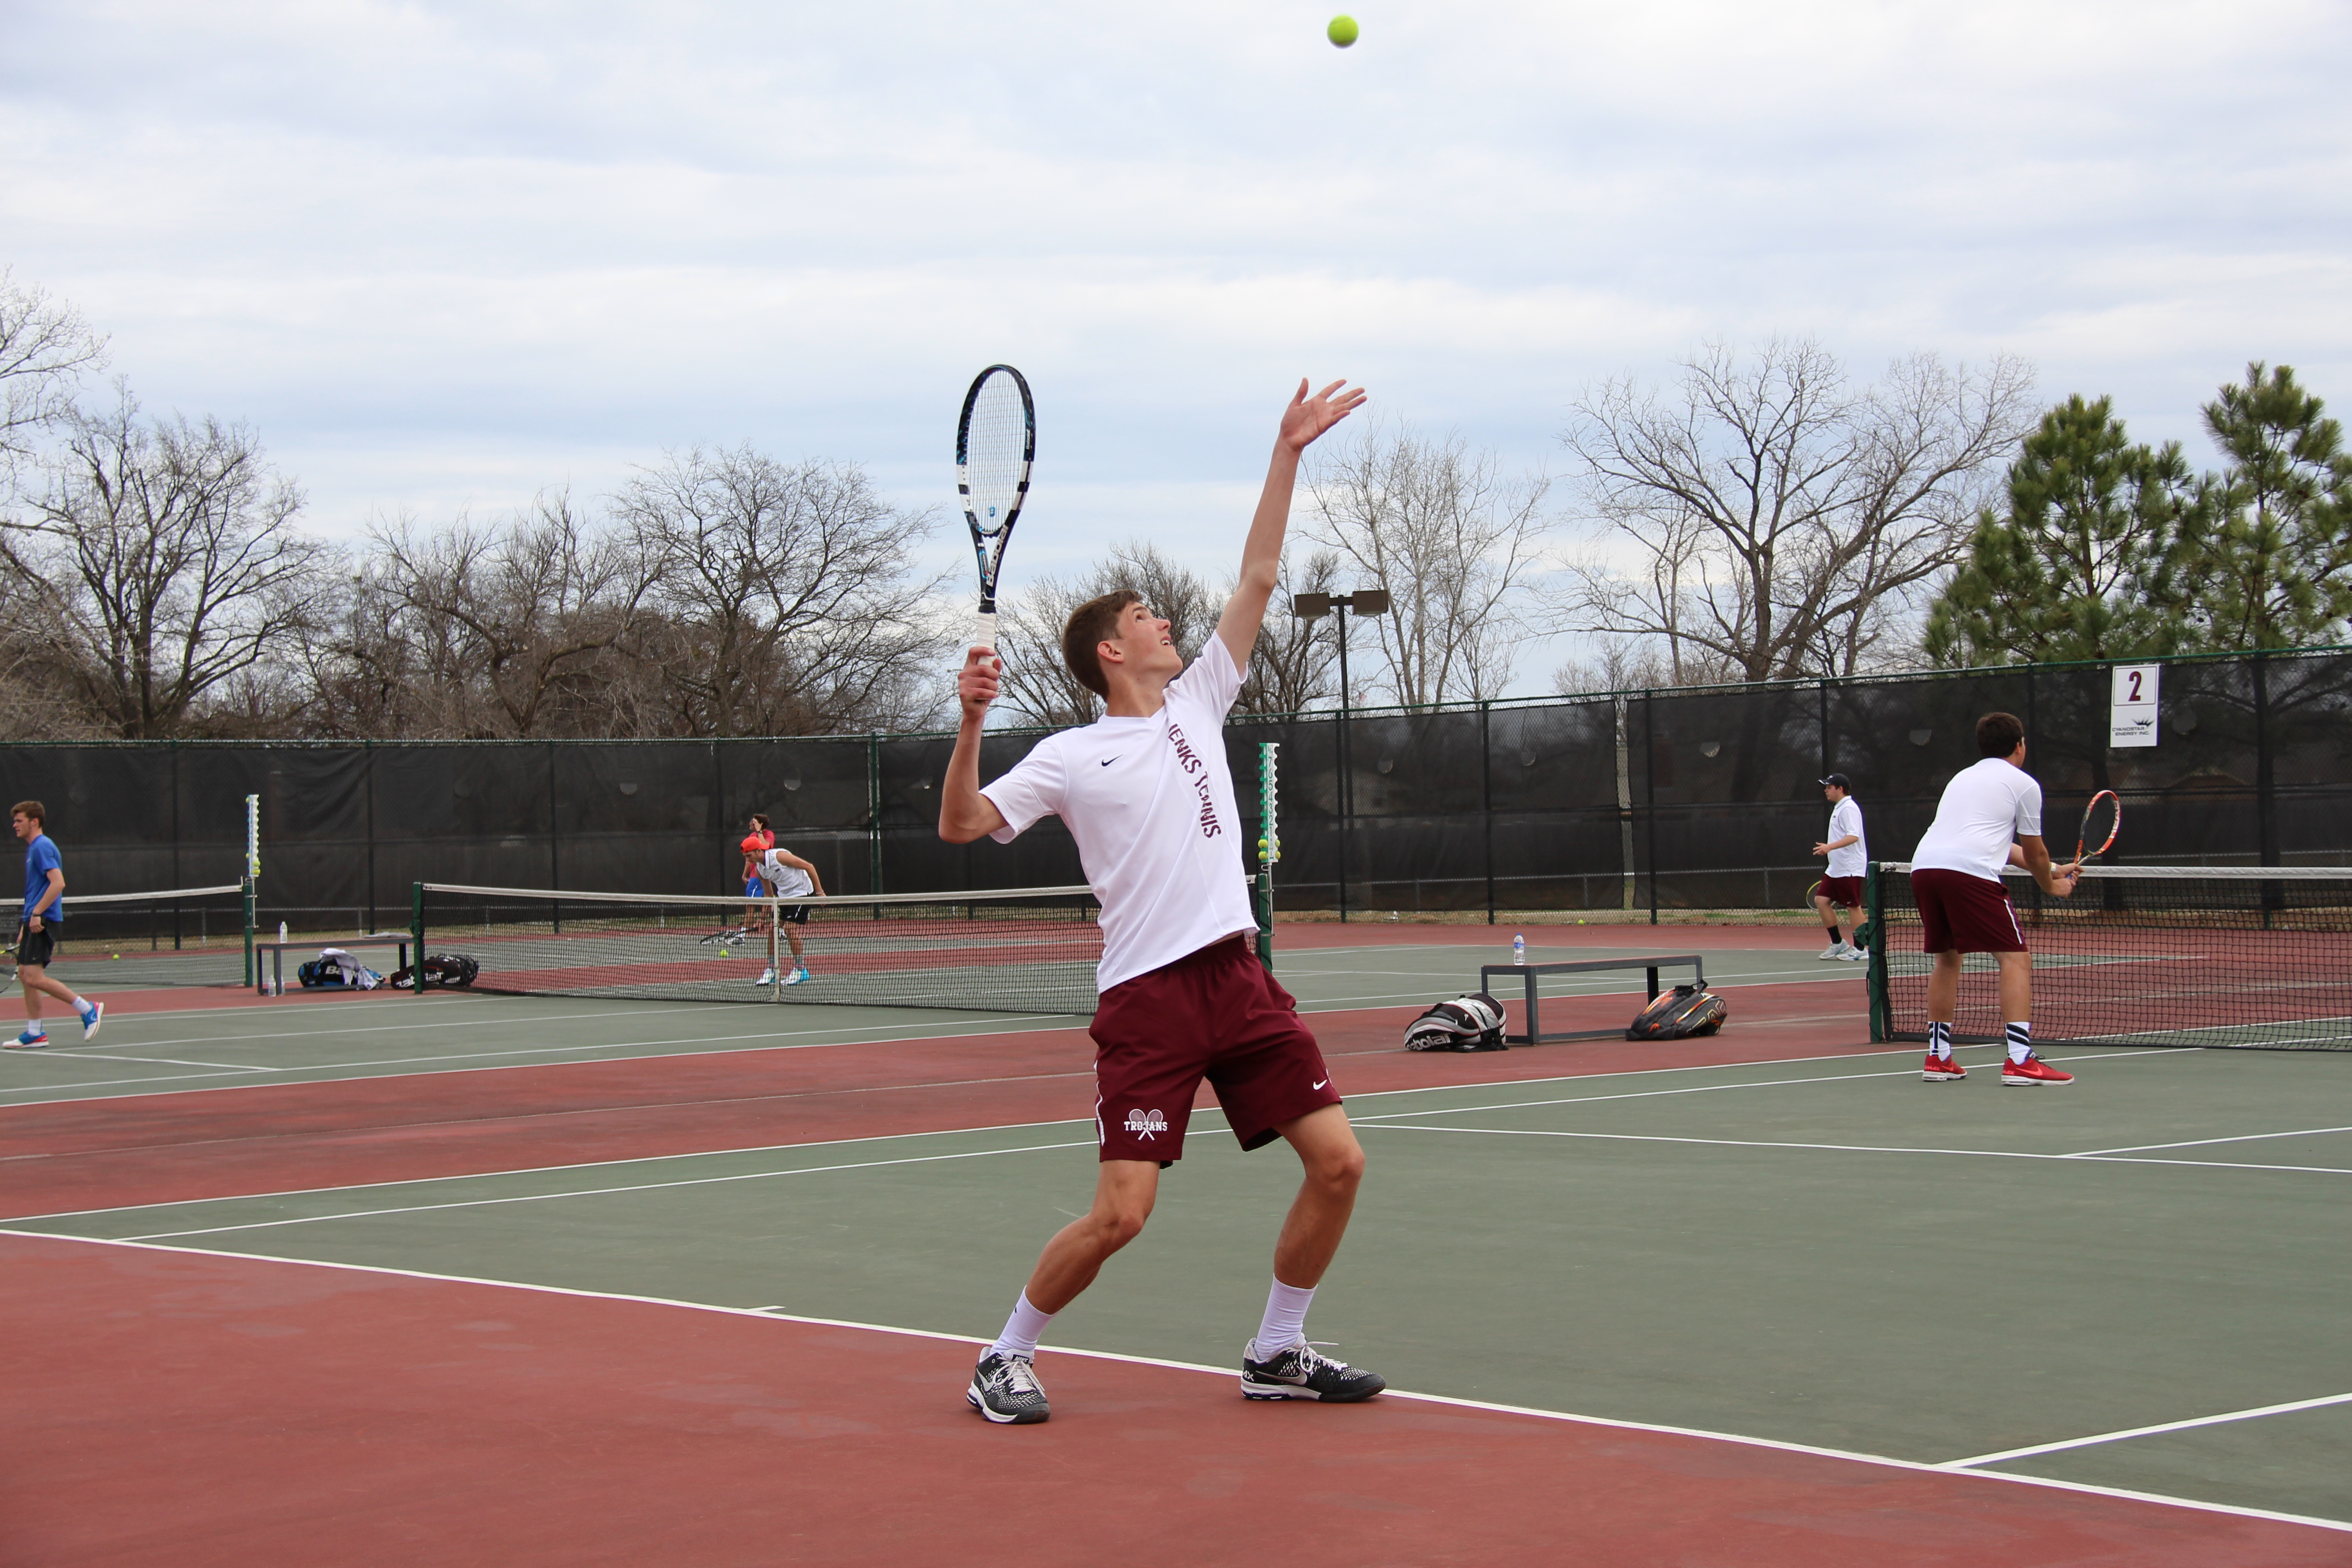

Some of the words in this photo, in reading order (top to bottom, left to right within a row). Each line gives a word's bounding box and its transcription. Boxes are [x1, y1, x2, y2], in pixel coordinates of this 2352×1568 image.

[2128, 671, 2141, 701] 2
[1269, 757, 1272, 767] 7
[1269, 768, 1273, 779] 6
[1269, 780, 1273, 791] 5
[1269, 792, 1273, 802] 4
[1269, 804, 1273, 814] 3
[1269, 815, 1273, 826] 2
[1124, 1121, 1168, 1132] TROJANS
[1242, 1367, 1254, 1382] AX
